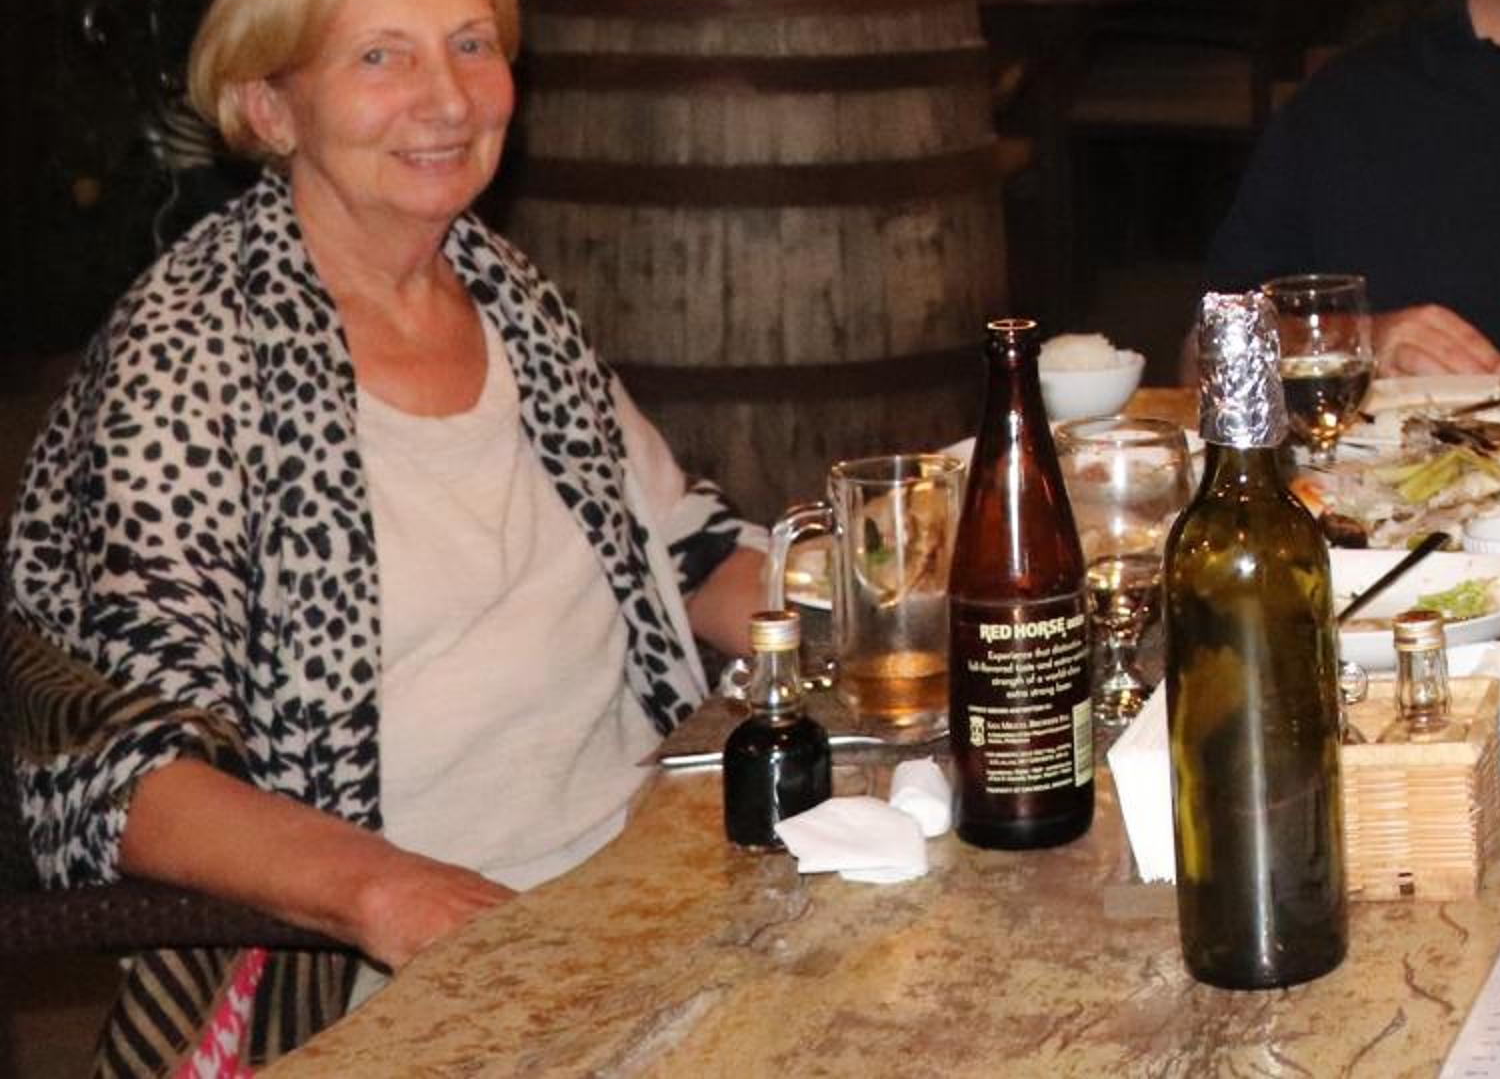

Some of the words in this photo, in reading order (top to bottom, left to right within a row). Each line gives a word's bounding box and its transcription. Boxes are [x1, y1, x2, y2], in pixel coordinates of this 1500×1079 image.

[979, 623, 1012, 643] RED
[1014, 616, 1067, 639] HORSE
[987, 650, 1033, 662] Experience
[1006, 689, 1029, 699] extra
[1030, 686, 1056, 697] strong
